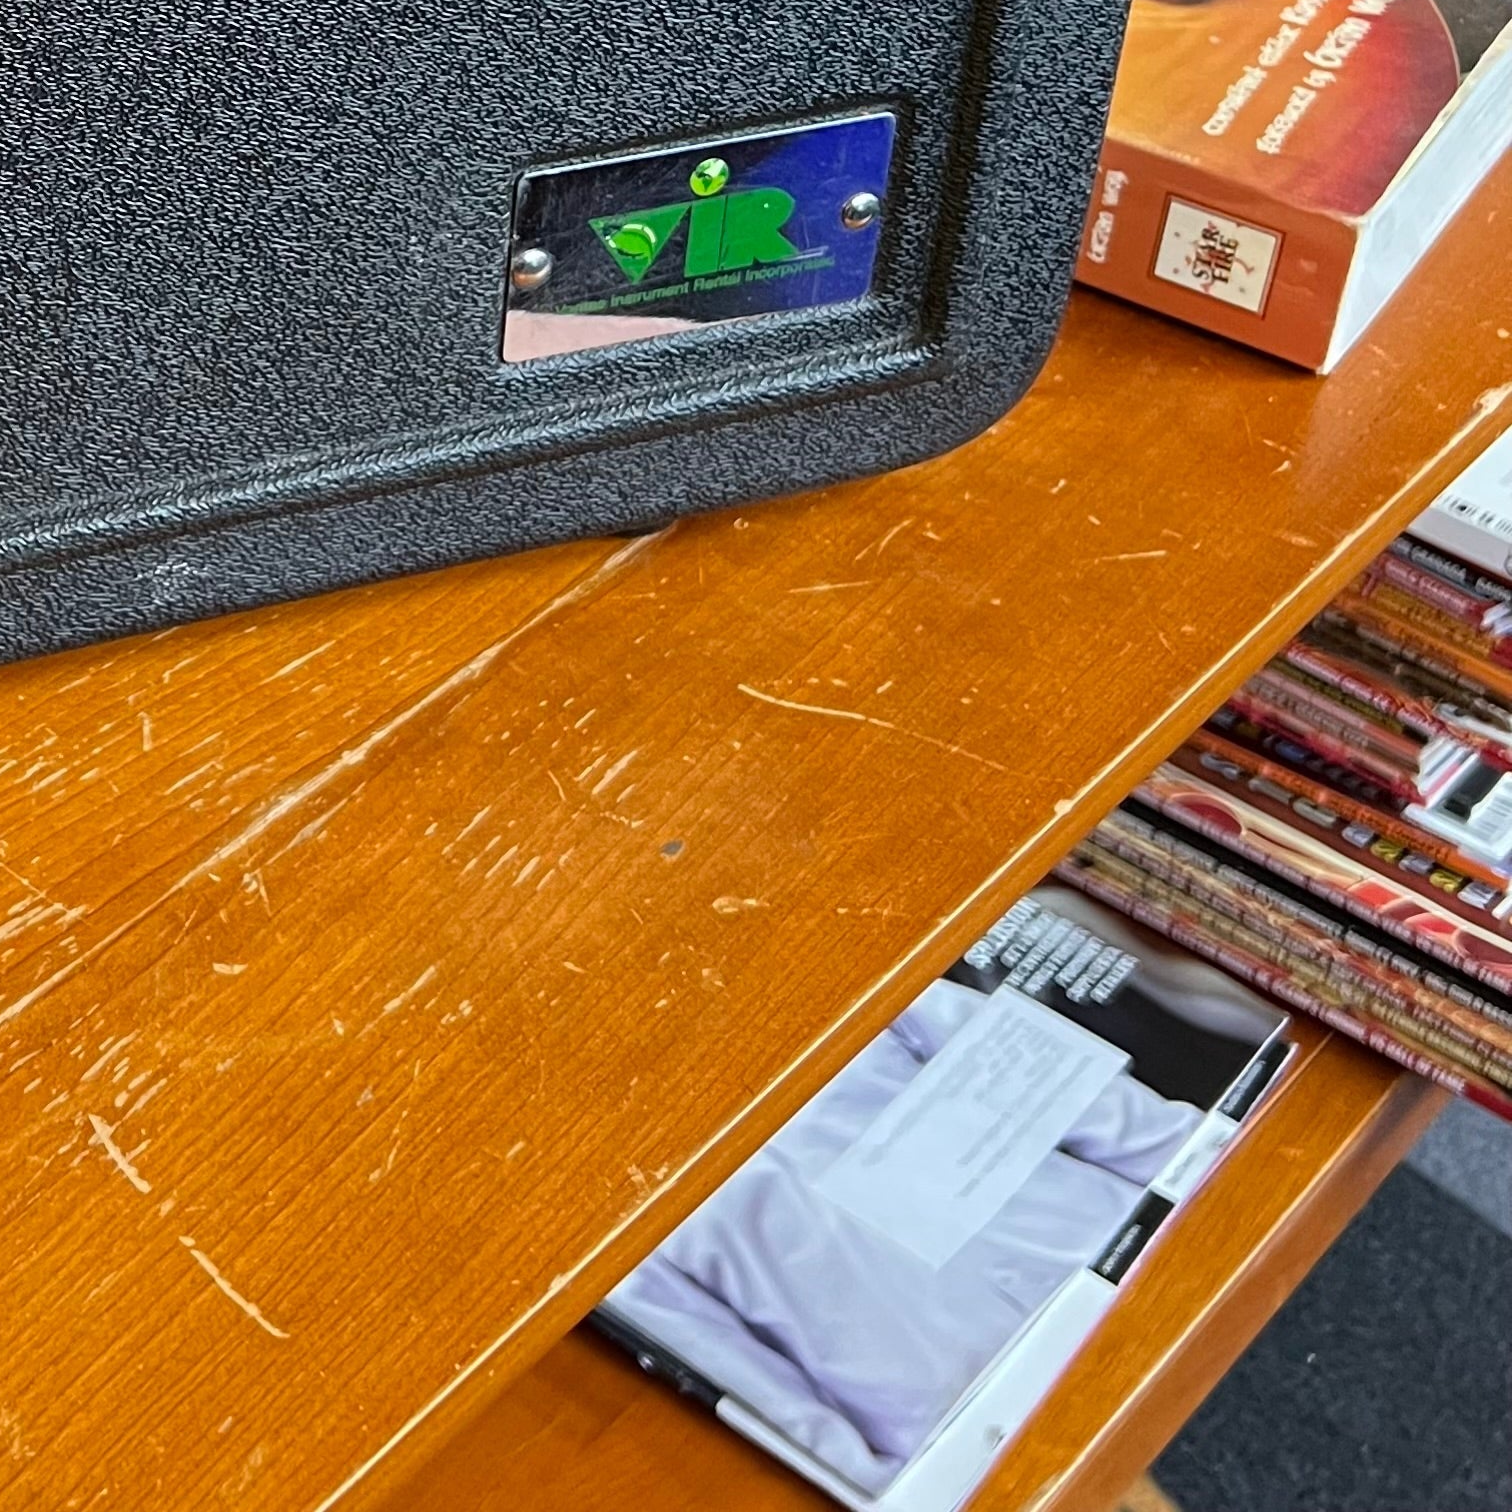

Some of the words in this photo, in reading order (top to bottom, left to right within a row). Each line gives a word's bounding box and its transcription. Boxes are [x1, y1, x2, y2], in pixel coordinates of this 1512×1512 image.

[1192, 227, 1221, 280] STAR
[1211, 235, 1240, 284] FIRE
[610, 282, 689, 307] Instrument
[693, 273, 741, 292] Rental
